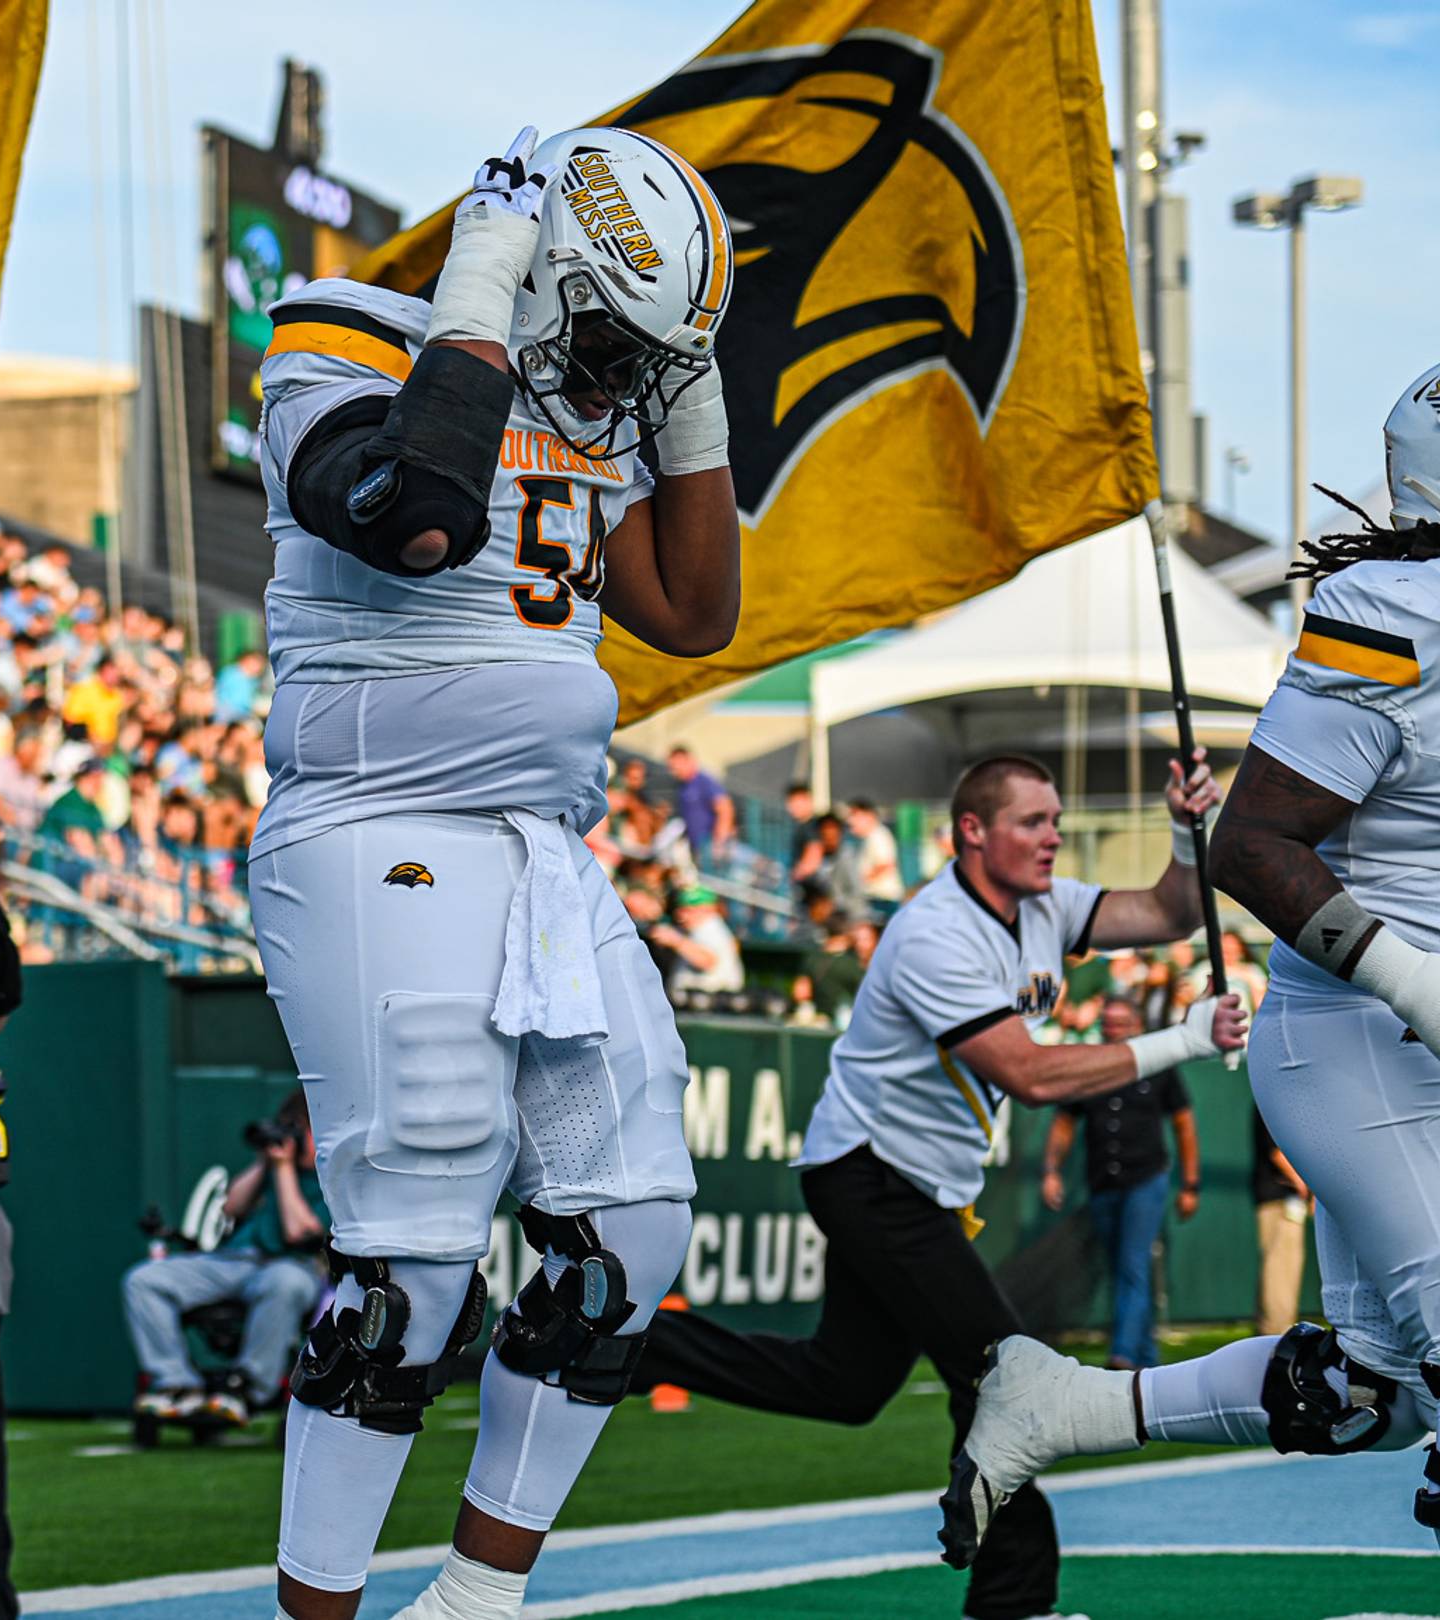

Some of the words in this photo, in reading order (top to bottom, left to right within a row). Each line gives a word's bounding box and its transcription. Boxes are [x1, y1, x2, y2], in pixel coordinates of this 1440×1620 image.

[565, 187, 613, 240] MISS
[573, 153, 664, 271] SOUTHERN
[685, 1213, 829, 1305] CLUB
